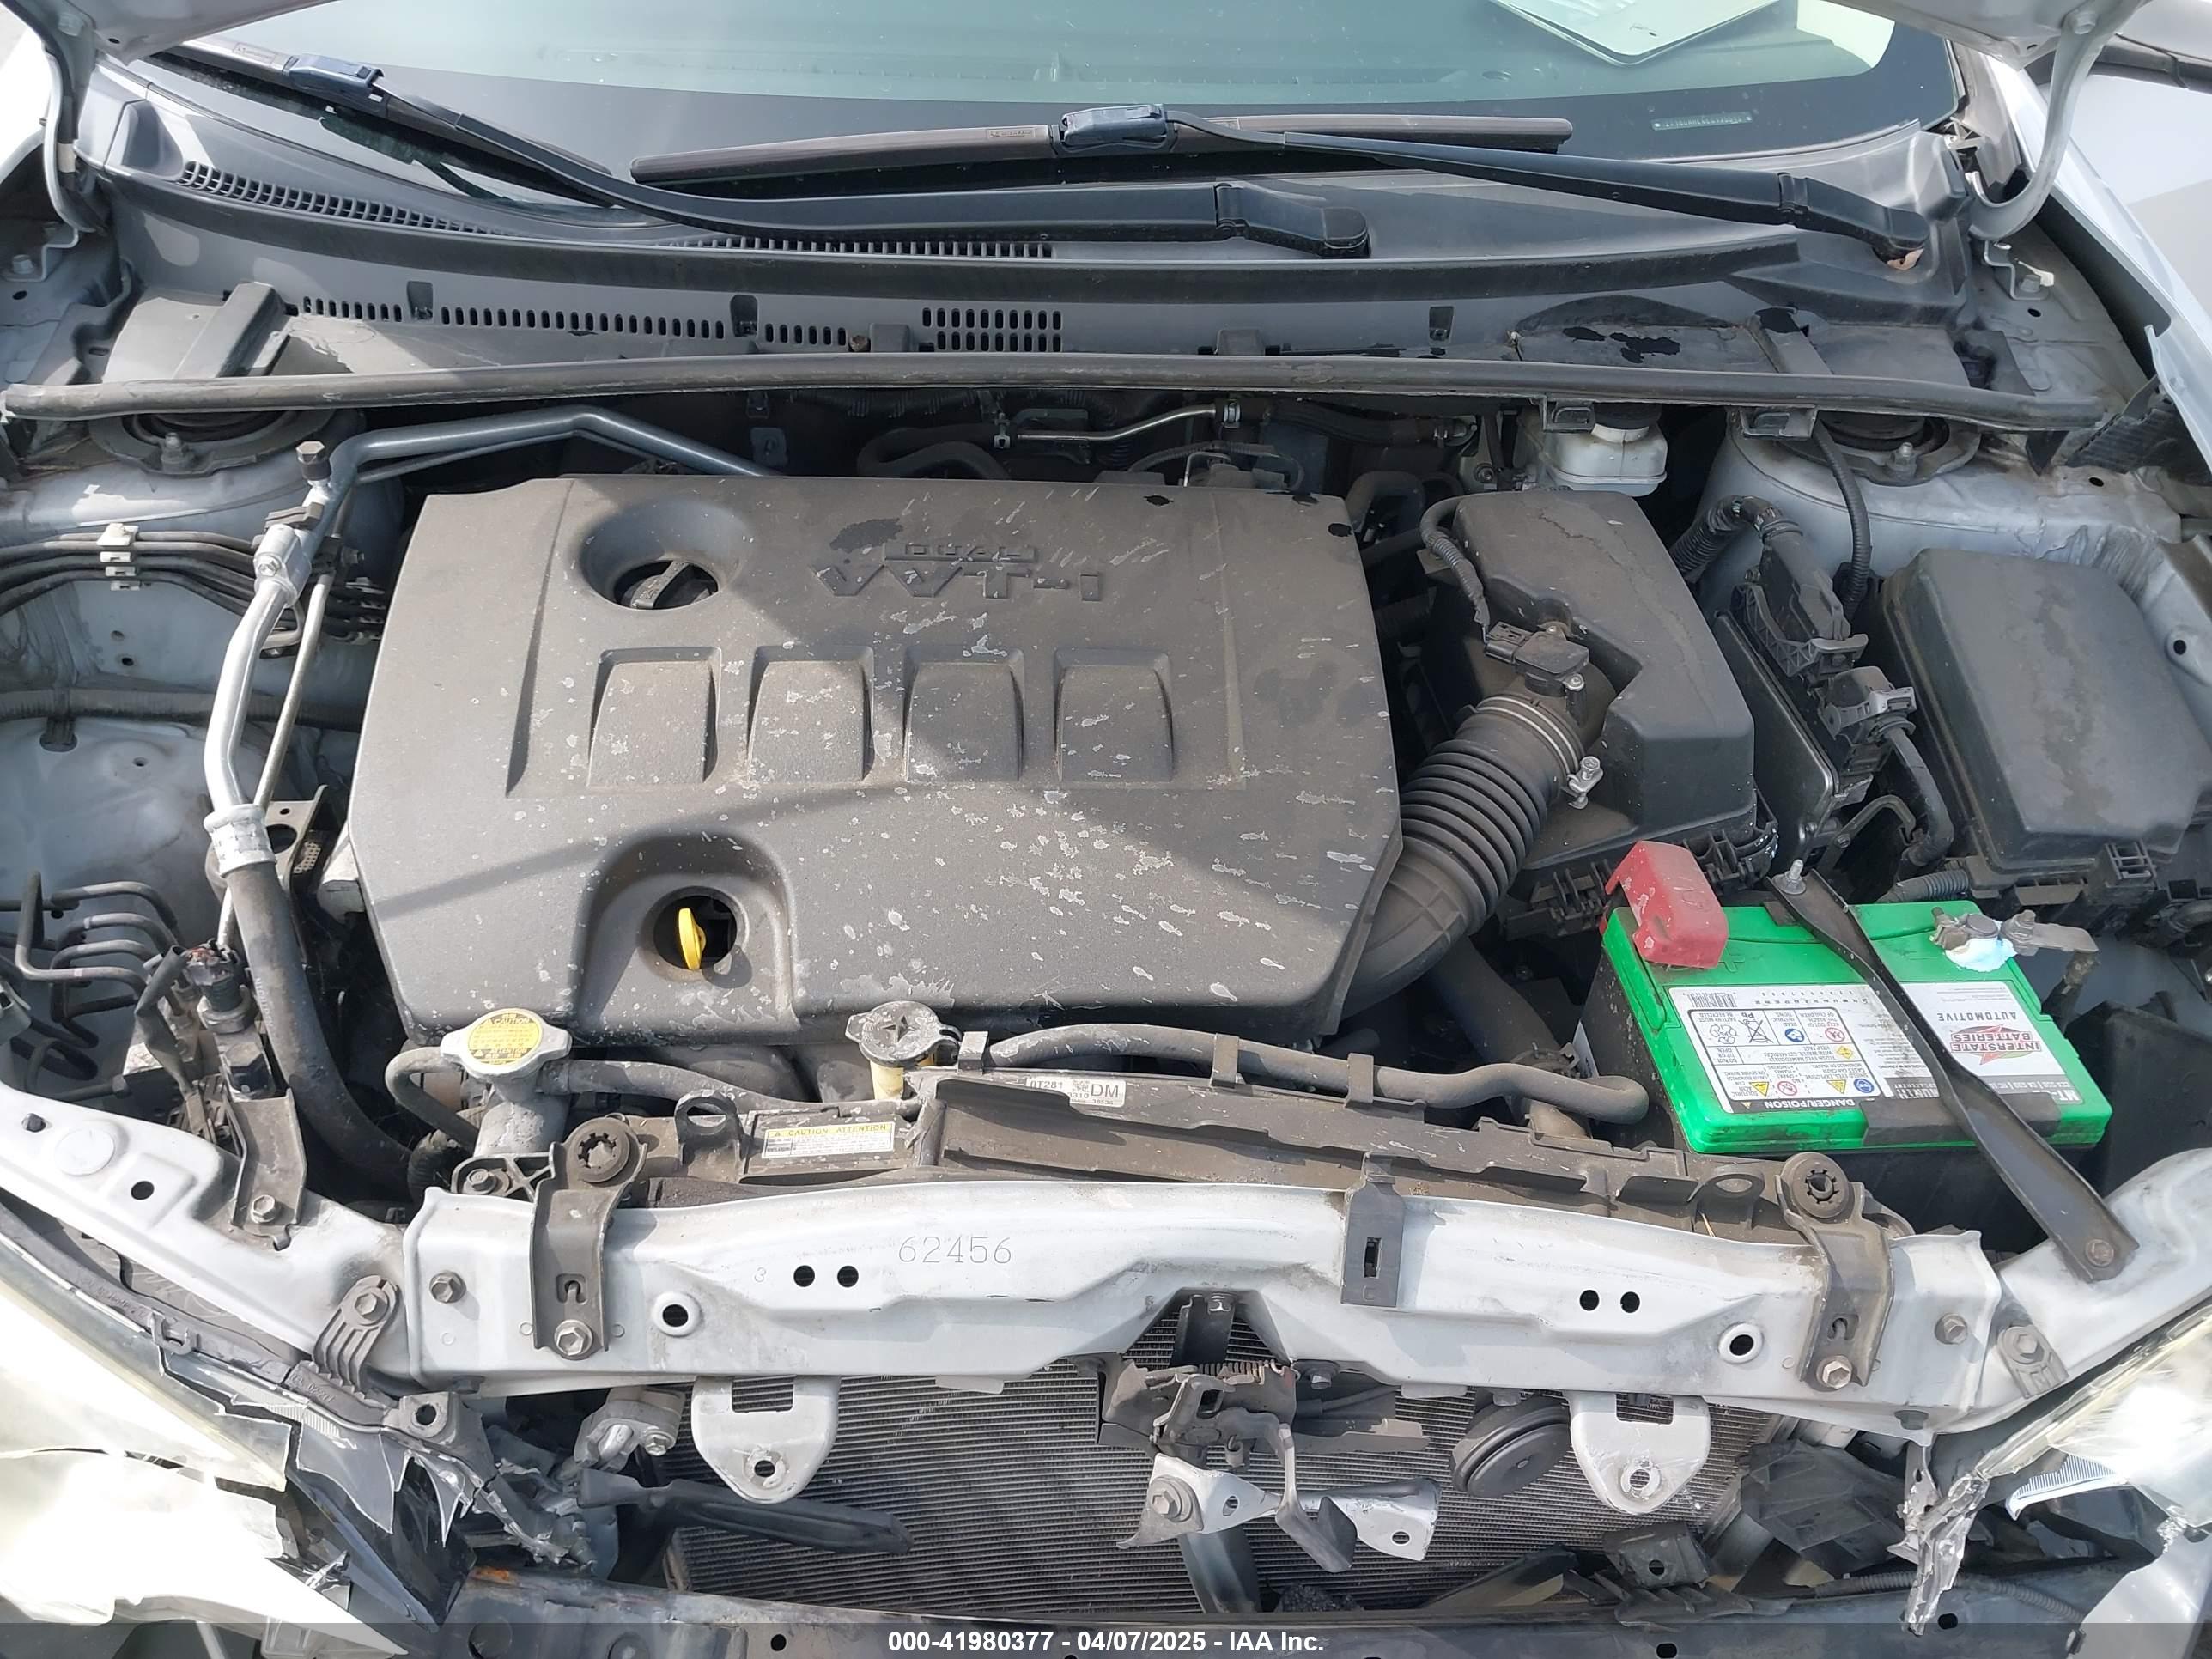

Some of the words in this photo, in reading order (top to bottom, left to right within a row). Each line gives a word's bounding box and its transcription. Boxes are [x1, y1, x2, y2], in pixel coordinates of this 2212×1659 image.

[1936, 1012, 2016, 1021] AUTOMOTIVE
[1953, 1033, 2031, 1042] BATTERIES
[1952, 1042, 2039, 1052] INTERSTATE
[1091, 1084, 1119, 1097] DM
[1765, 1099, 1855, 1109] DANGER/POISON
[836, 1124, 886, 1133] ATTENTION
[898, 1236, 1012, 1264] 62456
